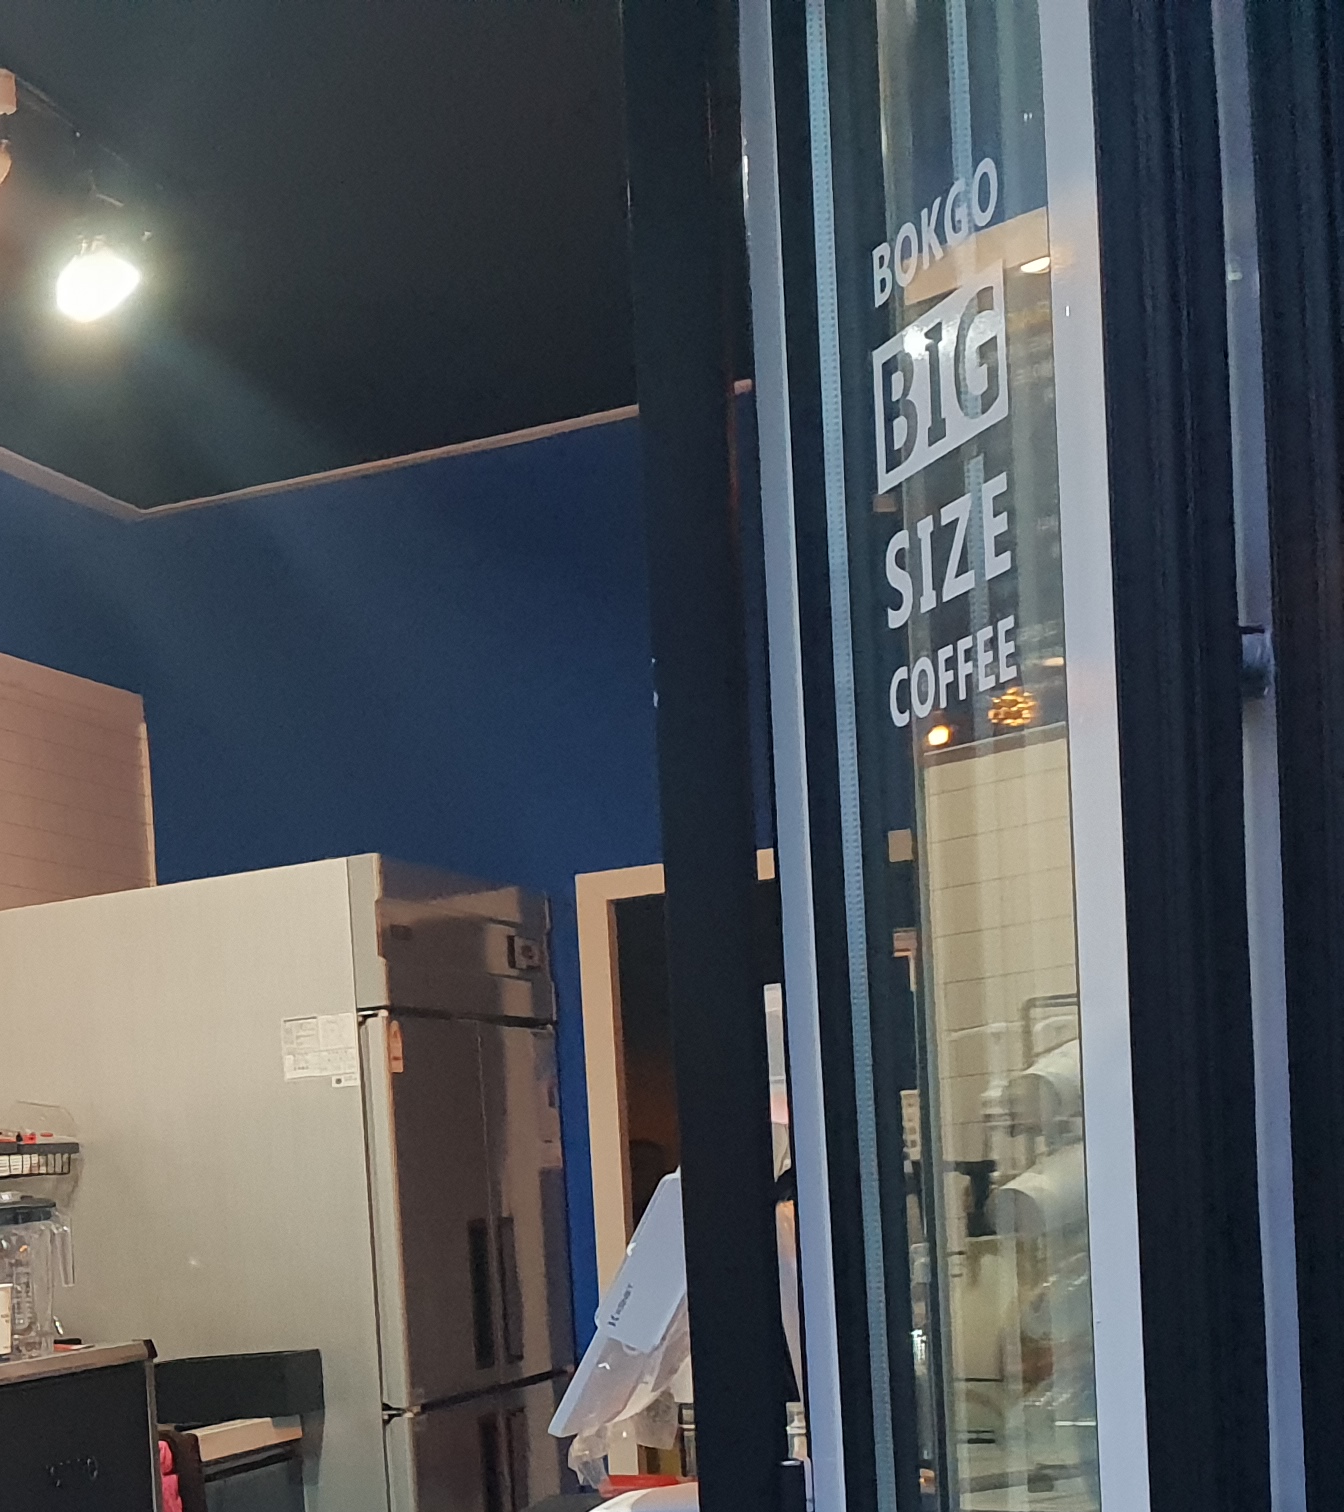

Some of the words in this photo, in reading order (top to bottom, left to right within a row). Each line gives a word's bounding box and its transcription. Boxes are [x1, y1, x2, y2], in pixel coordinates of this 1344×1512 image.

[872, 158, 998, 308] BOKGO
[882, 285, 1000, 472] BIG
[886, 472, 1012, 630] SIZE
[890, 615, 1017, 728] COFFEE
